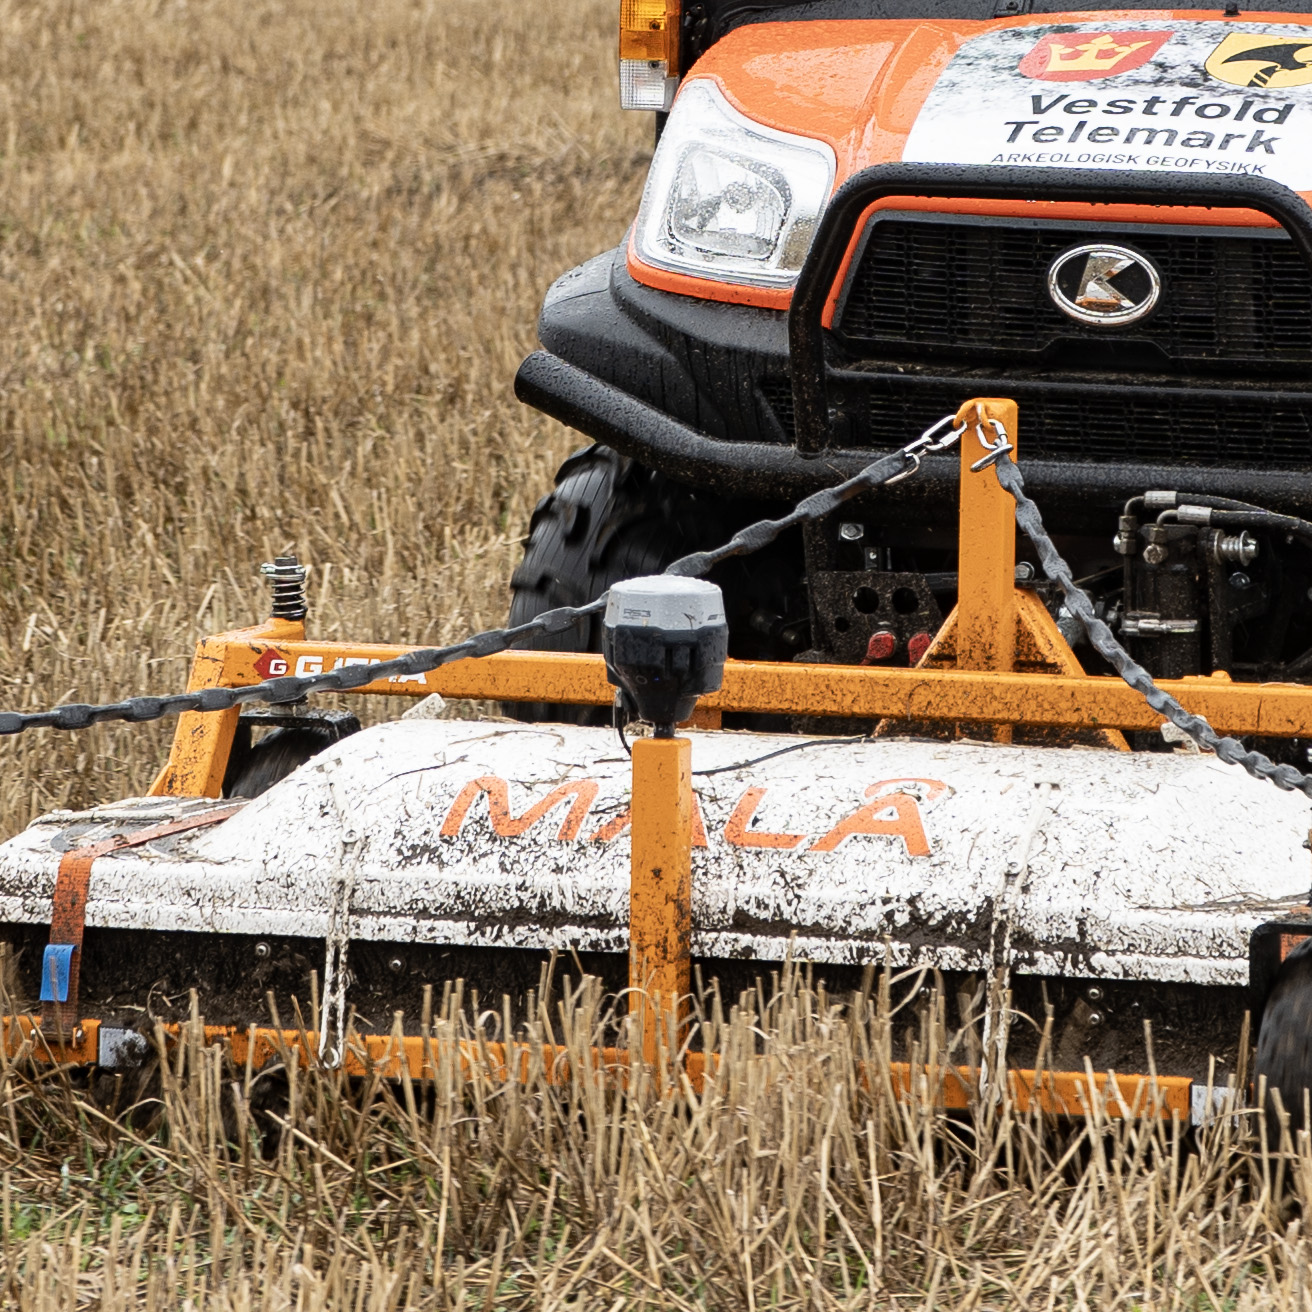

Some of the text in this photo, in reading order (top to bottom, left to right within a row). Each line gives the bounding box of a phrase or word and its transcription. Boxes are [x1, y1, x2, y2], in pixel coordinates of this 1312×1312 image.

[1029, 93, 1297, 126] Vestfold
[1003, 120, 1283, 155] Telemark
[990, 152, 1268, 175] ARKEOLOGISK GEOFYSIKK
